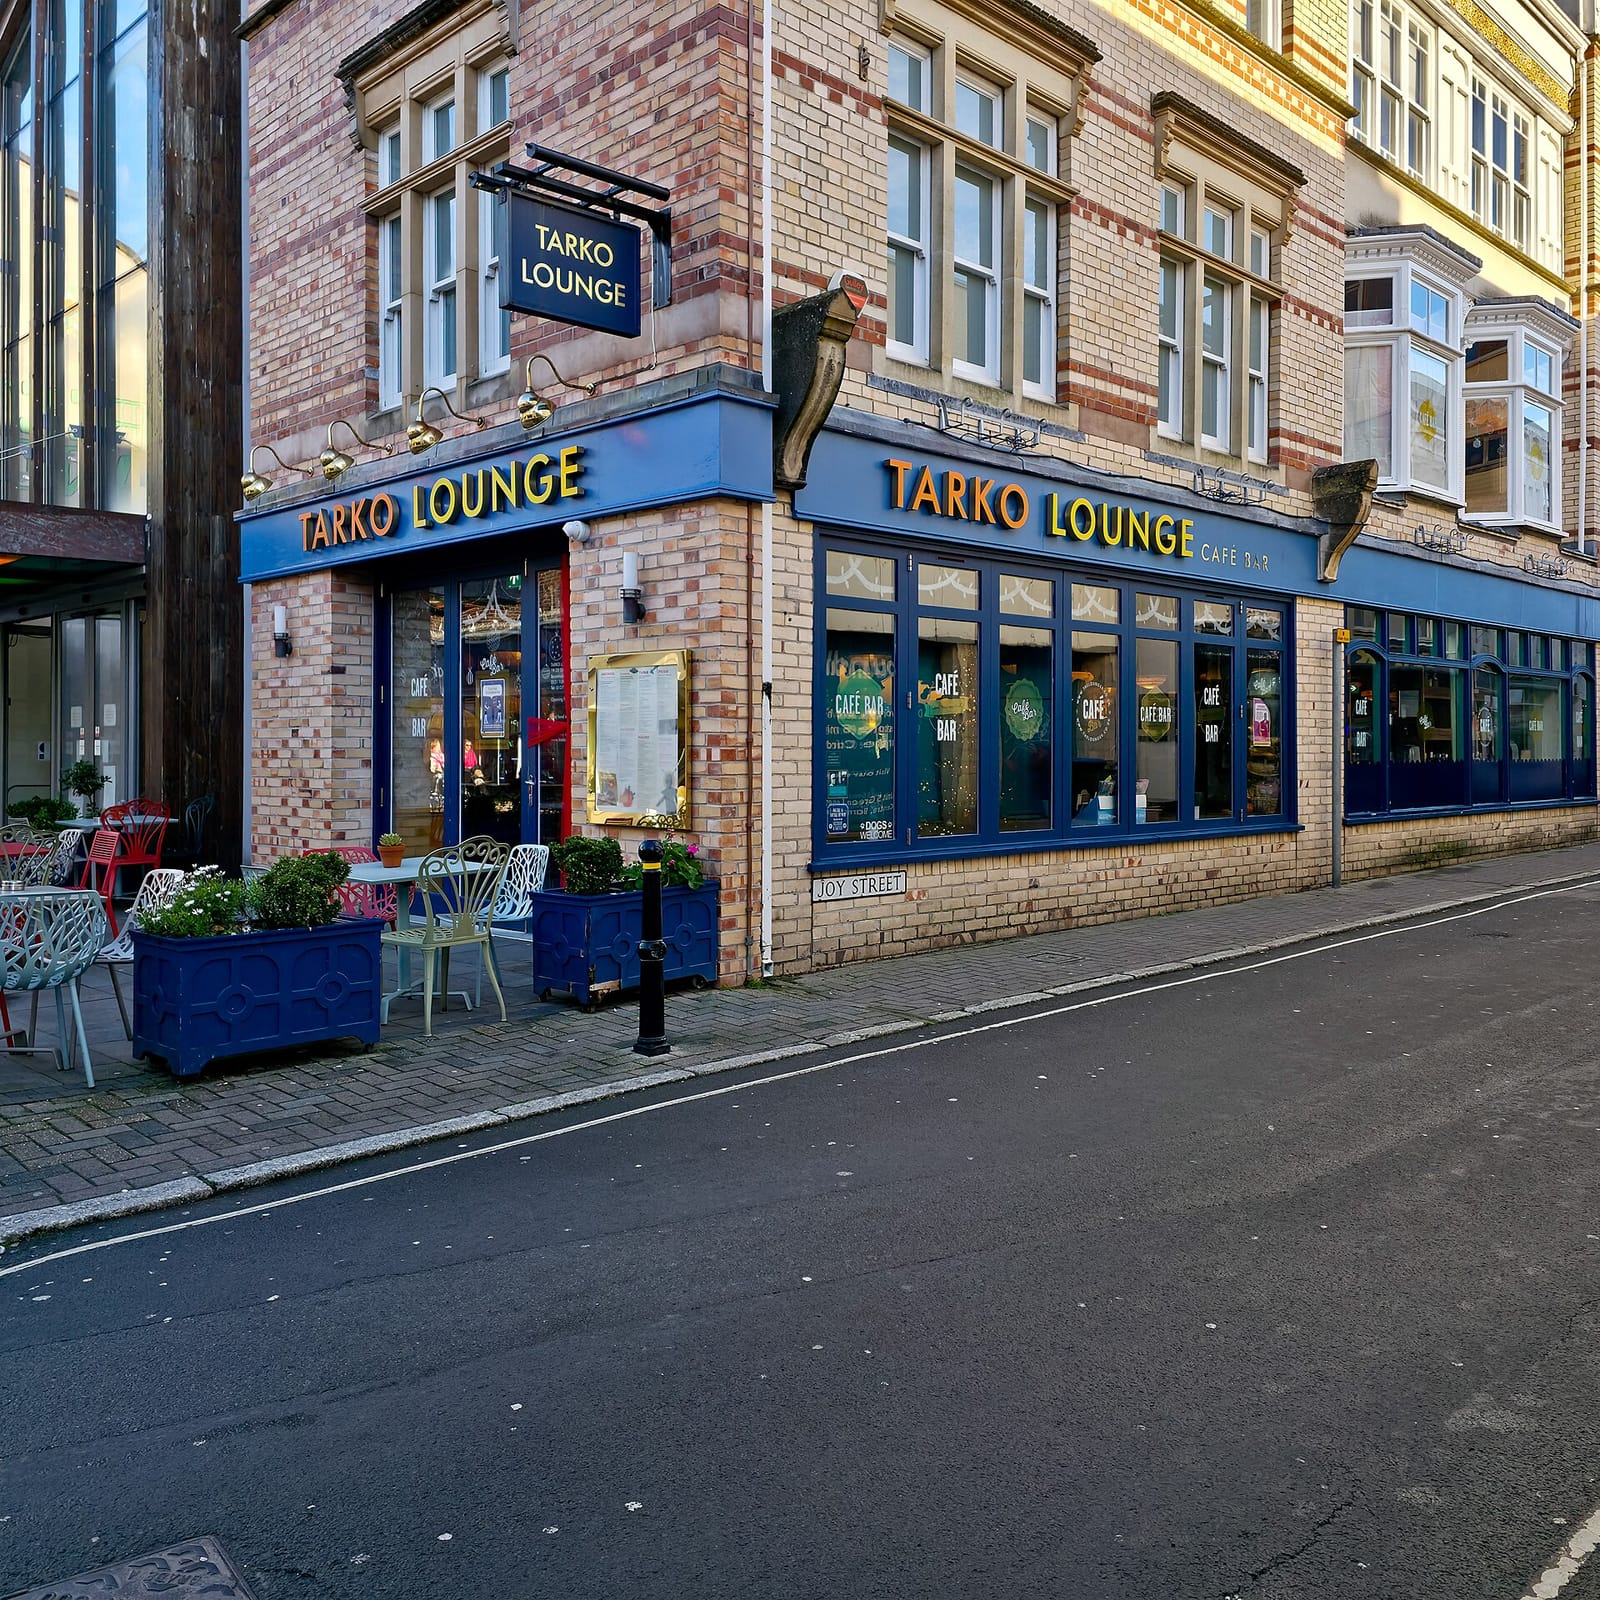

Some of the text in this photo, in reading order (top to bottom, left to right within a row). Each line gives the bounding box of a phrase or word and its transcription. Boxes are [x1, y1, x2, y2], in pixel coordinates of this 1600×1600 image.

[535, 223, 614, 268] TARKO
[521, 257, 626, 308] LOUNGE
[298, 445, 583, 552] TARKO LOUNGE
[883, 458, 1270, 573] TARKO LOUNGE CAFÉ BAR
[411, 674, 428, 697] CAFÉ
[935, 670, 959, 696] CAFÉ
[835, 691, 860, 715] CAFÉ
[864, 695, 884, 715] BAR
[1203, 685, 1220, 706] CAFÉ
[1083, 695, 1105, 720] CAFÉ
[1140, 703, 1172, 722] CAFÉ BAR
[412, 718, 426, 737] BAR
[937, 720, 957, 741] BAR
[1205, 724, 1219, 742] BAR
[860, 830, 893, 840] WELCOME
[865, 821, 888, 830] DOGS
[817, 874, 902, 897] JOY STREET
